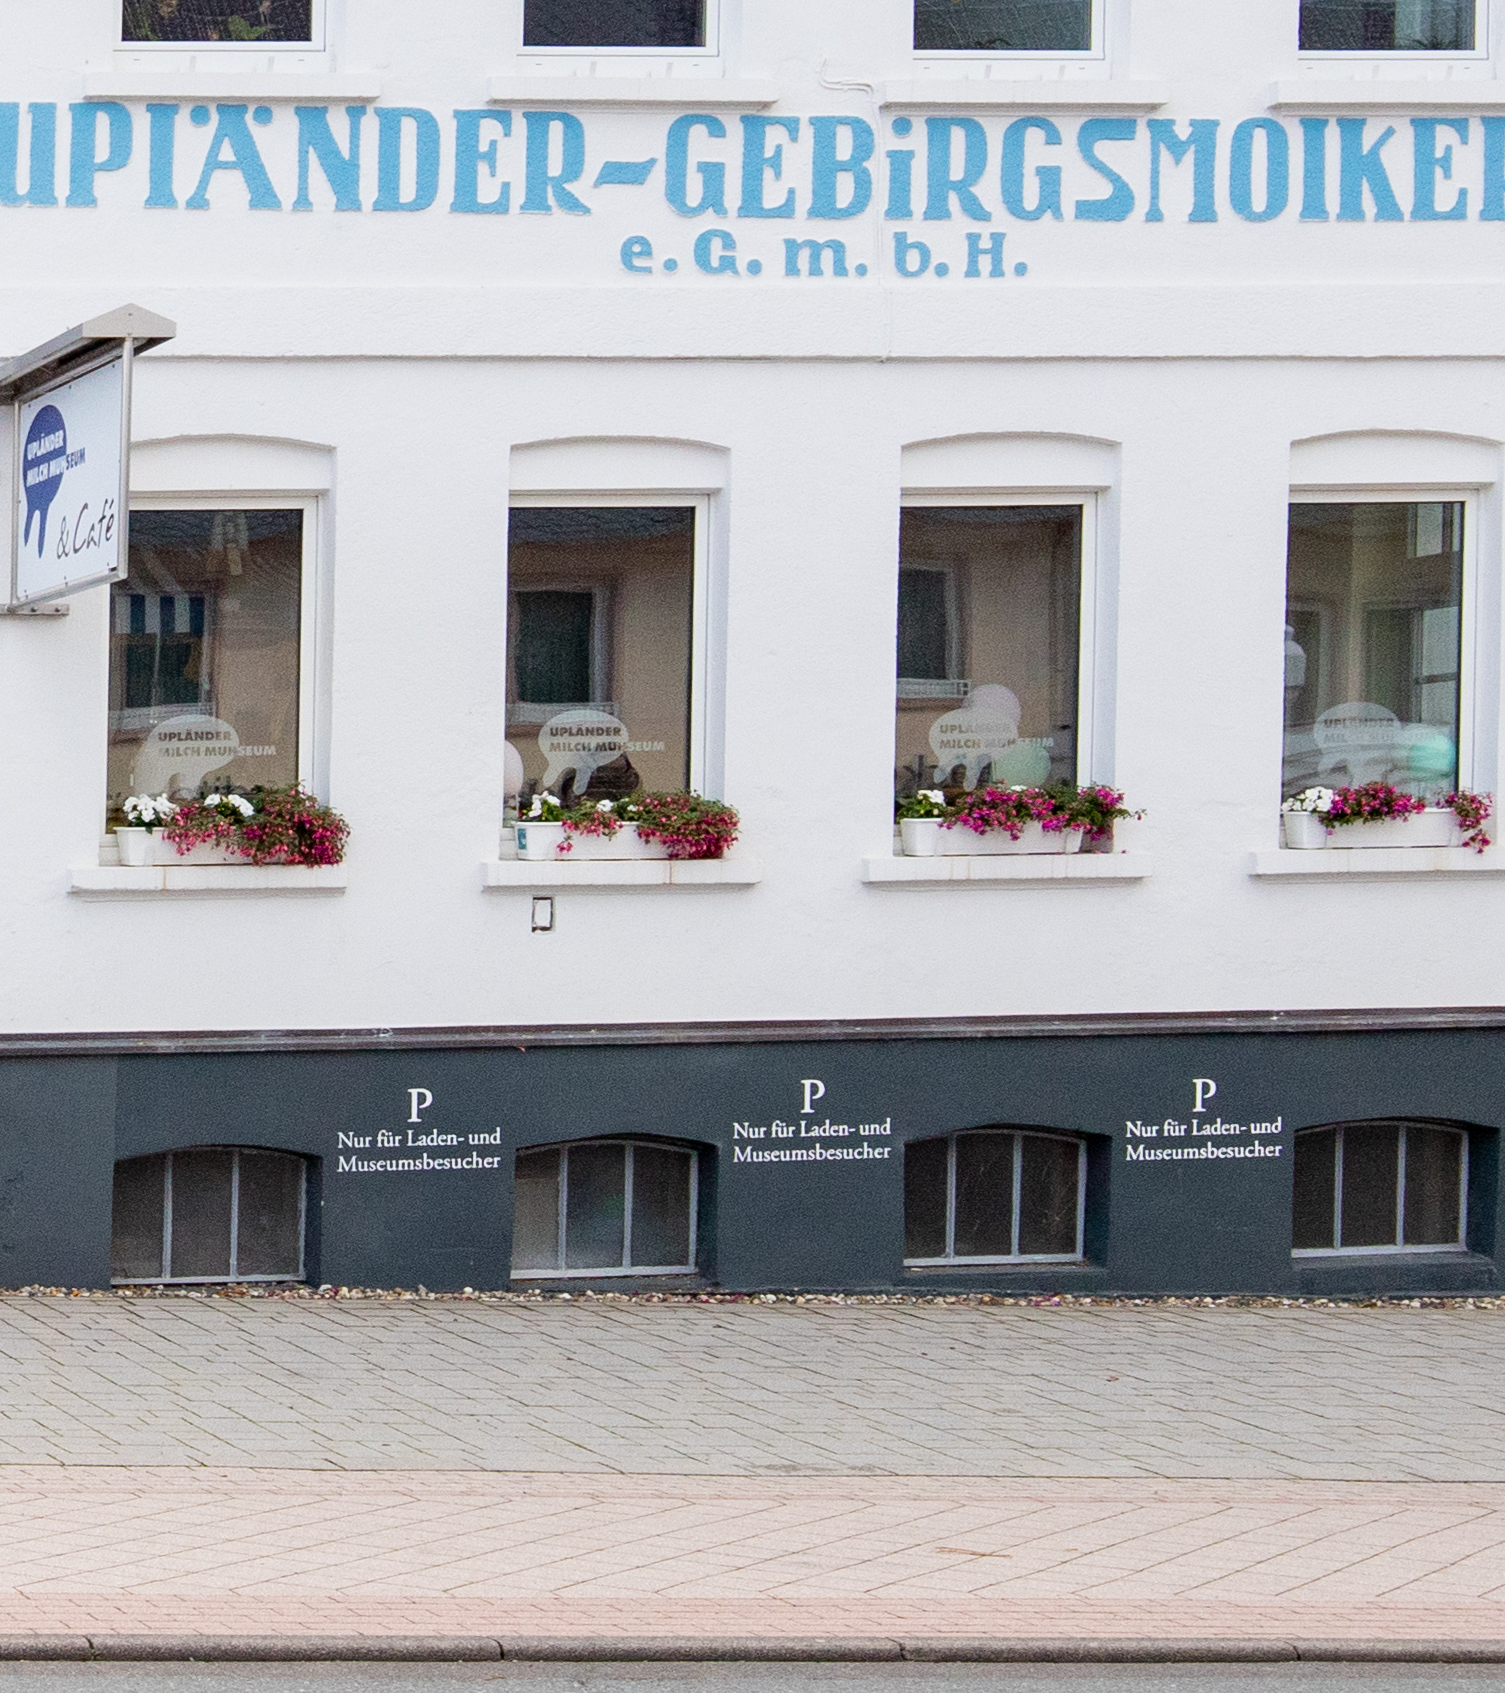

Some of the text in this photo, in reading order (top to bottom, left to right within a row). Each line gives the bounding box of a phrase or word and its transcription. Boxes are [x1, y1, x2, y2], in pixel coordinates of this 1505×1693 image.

[27, 430, 64, 460] UPLÄNDER
[27, 462, 49, 487] MILCH
[158, 728, 232, 742] UPLÄNDER
[549, 723, 622, 737] UPLÄNDER
[407, 1088, 433, 1122] P
[800, 1079, 825, 1113] P
[1192, 1079, 1217, 1112] P
[337, 1126, 501, 1149] Nur für Laden- und
[733, 1118, 891, 1139] Nur für Laden- und
[1126, 1117, 1282, 1138] Nur für Laden- und
[733, 1142, 891, 1162] Museumsbesucher
[1126, 1140, 1282, 1160] Museumsbesucher
[337, 1151, 501, 1173] Museumsbesucher
